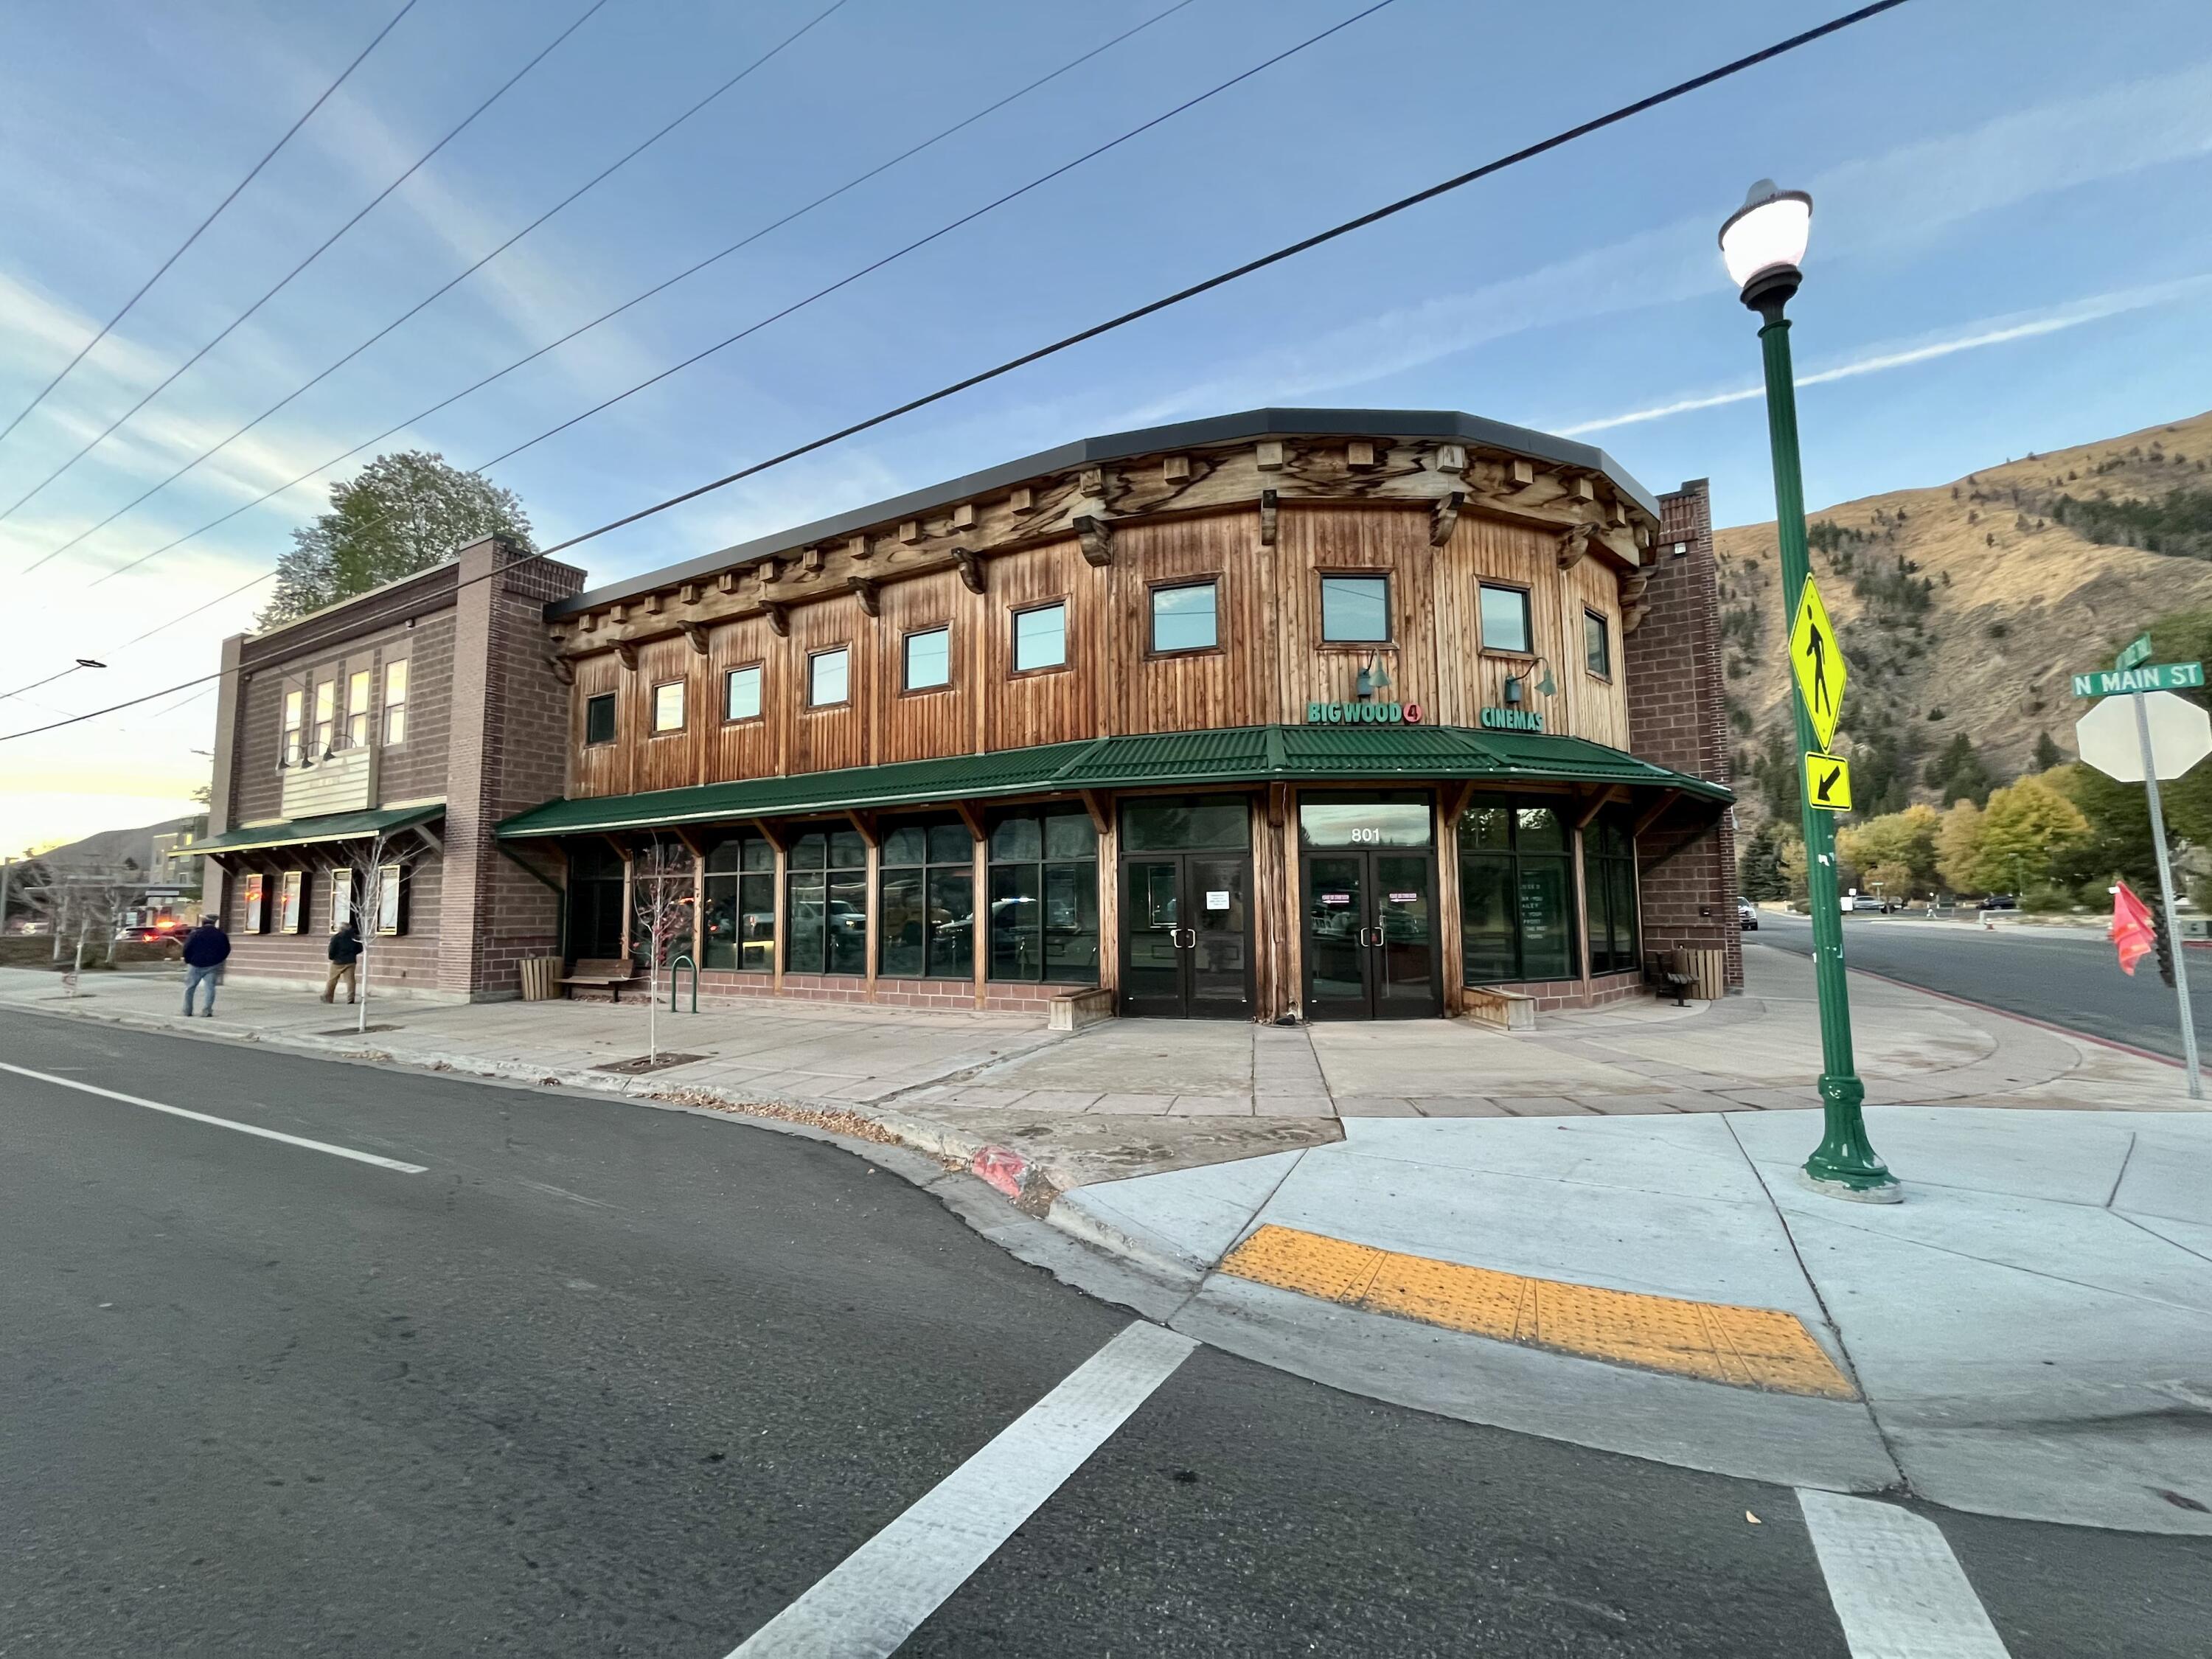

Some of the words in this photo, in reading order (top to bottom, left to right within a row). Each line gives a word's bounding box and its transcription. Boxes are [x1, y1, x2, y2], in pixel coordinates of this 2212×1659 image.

[2074, 675, 2092, 695] N
[2101, 668, 2160, 692] MAIN
[2170, 664, 2197, 685] ST
[1308, 703, 1341, 723] BIG
[1342, 703, 1402, 723] WOOD
[1406, 703, 1419, 720] 4
[1481, 708, 1543, 731] CINEMAS
[1352, 828, 1380, 842] 801
